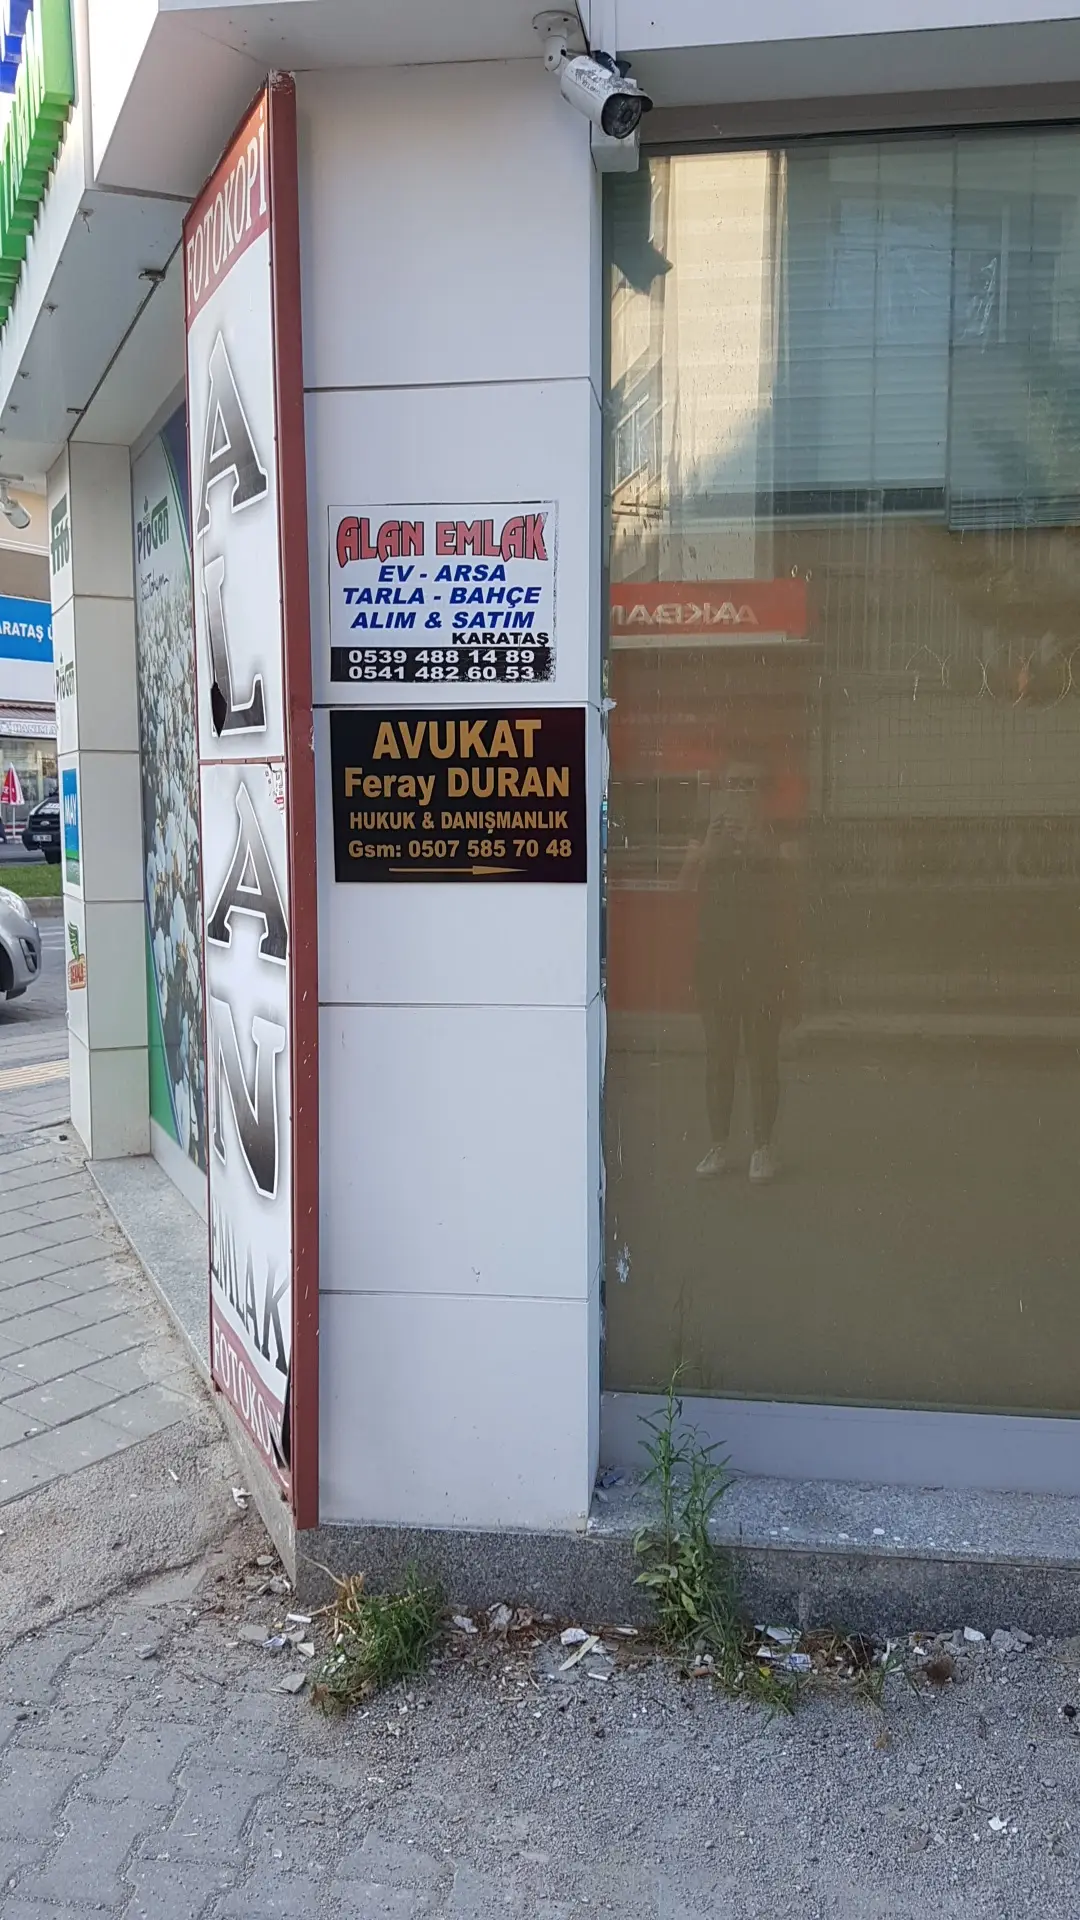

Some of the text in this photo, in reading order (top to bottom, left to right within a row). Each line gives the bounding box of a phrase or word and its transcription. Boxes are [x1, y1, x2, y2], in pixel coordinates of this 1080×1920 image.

[187, 106, 267, 315] FOTOKOPİ
[336, 512, 548, 568] ALAN EMLAK
[378, 564, 415, 582] EV
[434, 563, 507, 582] ARSA
[342, 587, 425, 605] TARLA
[449, 586, 541, 609] BAHÇE
[0, 620, 44, 642] RATAŞ
[350, 611, 535, 629] ALIM & SATIM
[451, 632, 549, 646] KARATAŞ
[349, 650, 535, 664] 0539 488 14 89
[349, 666, 535, 680] 0541 482 60 53
[374, 719, 542, 759] AVUKAT
[345, 767, 569, 805] Feray DURAN
[350, 811, 568, 834] HUKUK & DANIŞMANLIK
[348, 839, 572, 858] Gsm: 0507 585 70 48
[211, 1196, 290, 1376] EMLAK
